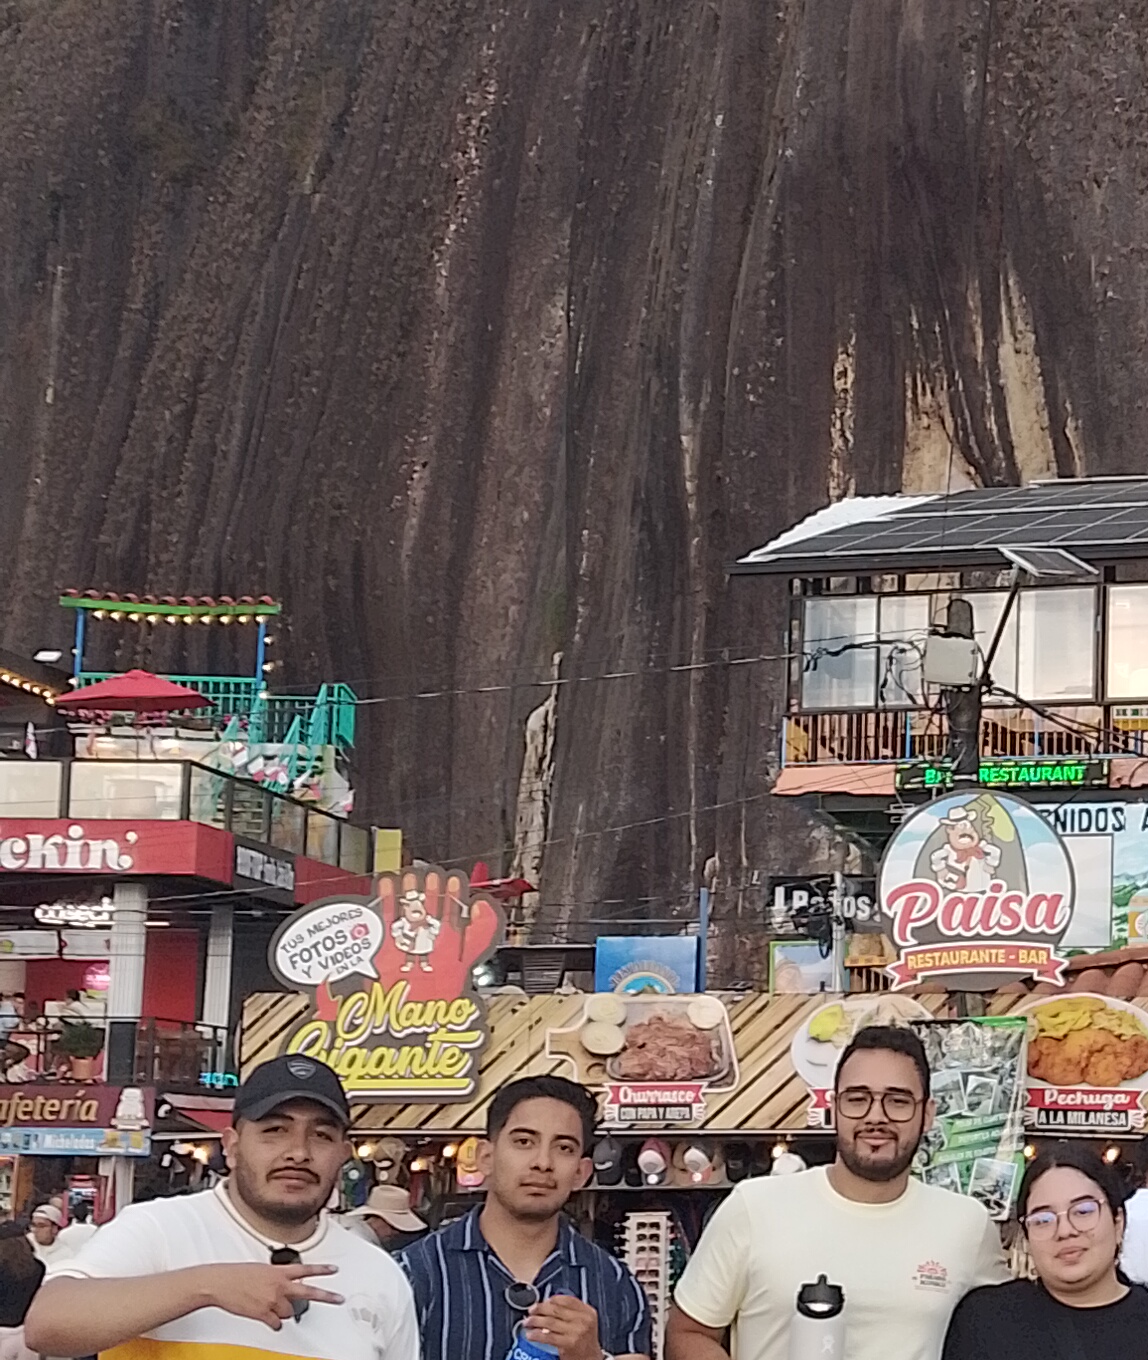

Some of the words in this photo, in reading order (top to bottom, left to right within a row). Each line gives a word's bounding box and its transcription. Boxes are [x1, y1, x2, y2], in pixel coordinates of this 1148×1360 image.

[886, 883, 1068, 945] Paisa
[280, 935, 304, 954] TUS
[306, 908, 363, 938] MEJORES
[288, 929, 348, 970] FOTOS
[302, 965, 313, 979] Y
[317, 937, 372, 971] VIDEOS
[350, 956, 364, 968] LA
[907, 946, 1006, 969] RESTAURANTE
[1018, 951, 1048, 963] BAR
[336, 981, 477, 1040] Mano
[618, 1086, 696, 1103] Churrasco
[1043, 1089, 1131, 1111] Pechuga
[1039, 1110, 1048, 1125] A
[1049, 1110, 1065, 1126] LA
[1066, 1111, 1128, 1127] MILANESA
